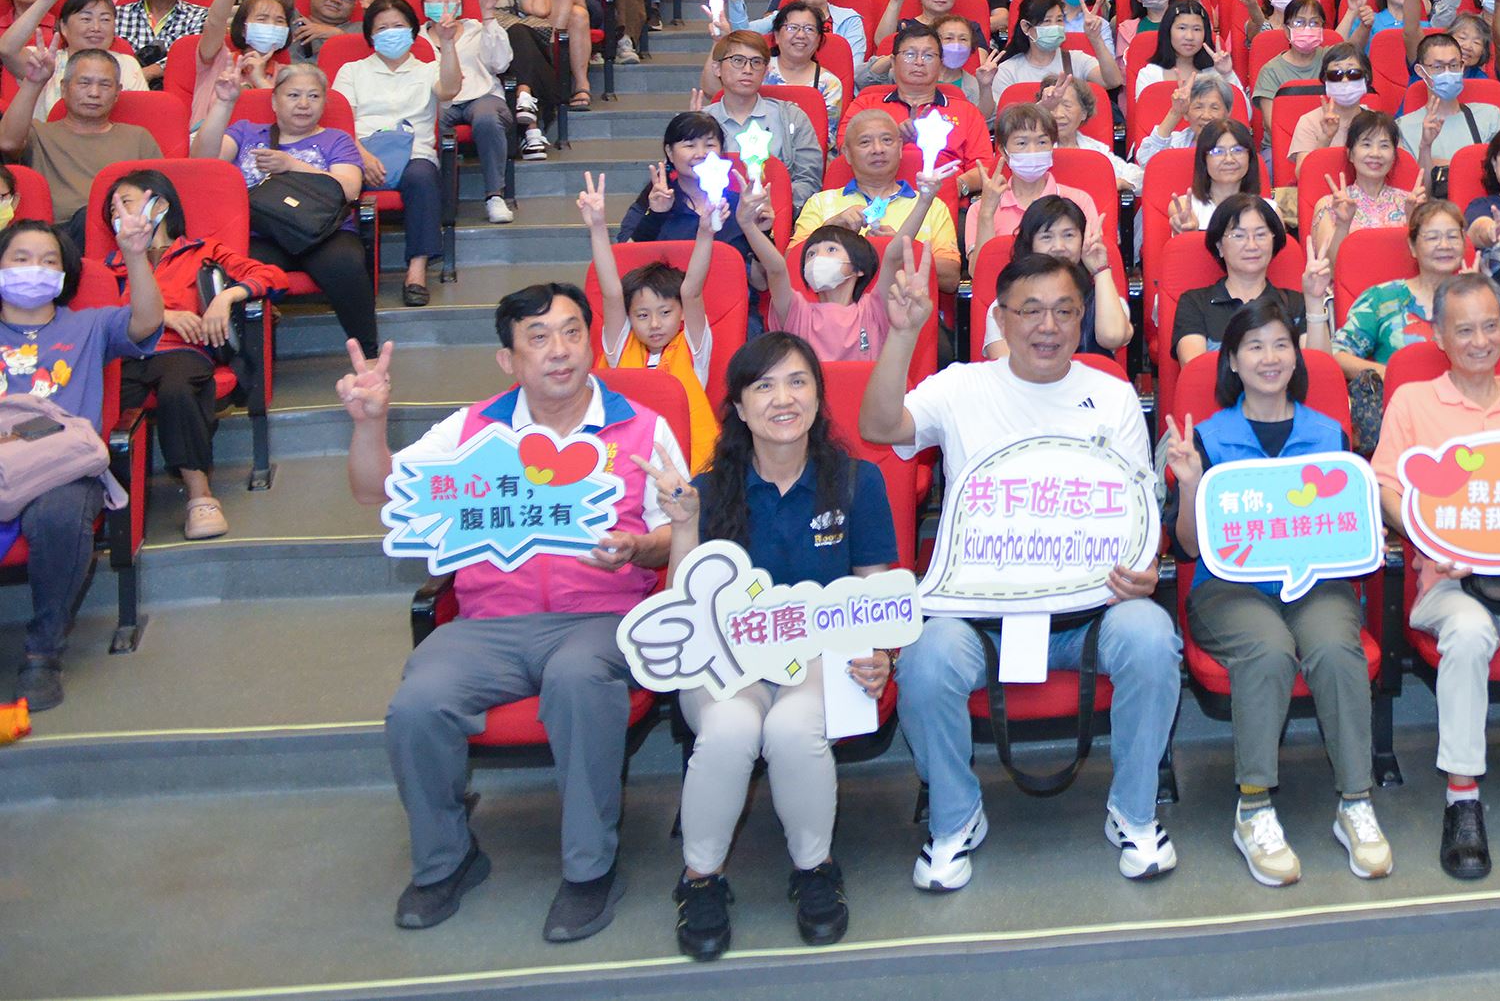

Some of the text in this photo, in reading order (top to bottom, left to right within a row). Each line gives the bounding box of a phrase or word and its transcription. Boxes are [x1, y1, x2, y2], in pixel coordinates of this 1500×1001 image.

[430, 473, 534, 500] 熱心有，
[1218, 488, 1273, 514] 有你，
[460, 503, 572, 530] 腹肌沒有
[1222, 512, 1358, 543] 世界直接升級
[1027, 529, 1060, 566] dong
[1065, 530, 1081, 560] zii
[730, 605, 808, 645] 按慶
[817, 598, 912, 630] on kiang
